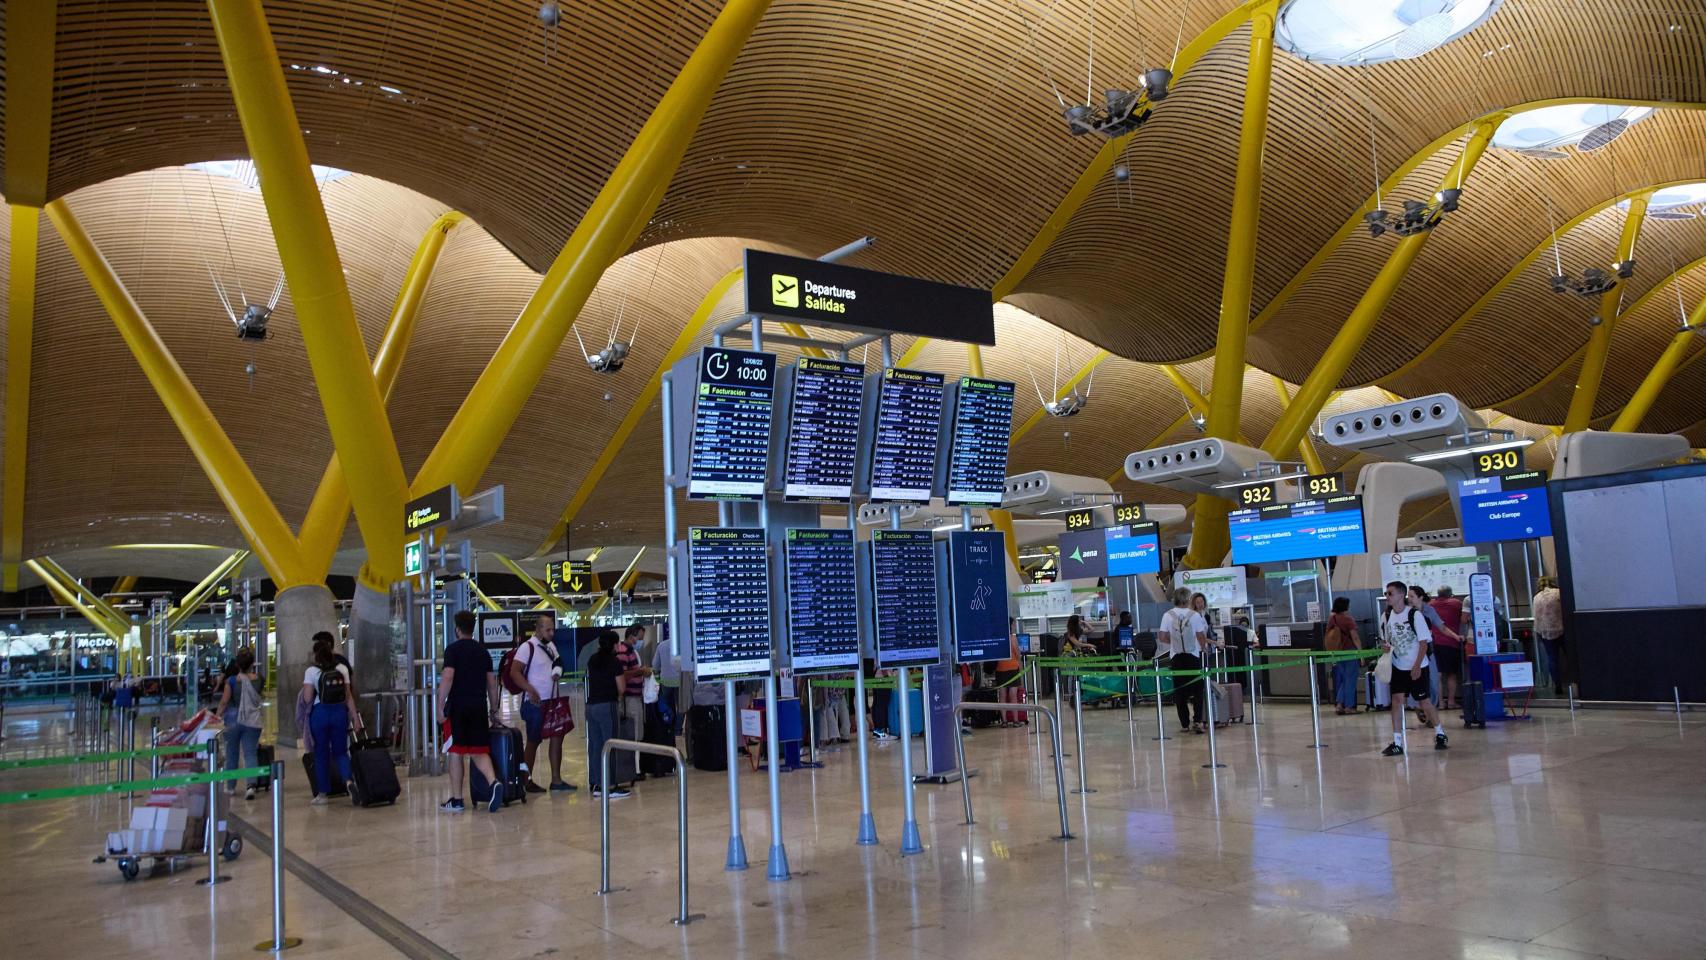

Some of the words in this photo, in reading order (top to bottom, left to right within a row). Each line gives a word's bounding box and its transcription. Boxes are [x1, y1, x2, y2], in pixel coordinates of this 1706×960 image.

[804, 280, 856, 300] Departures
[805, 295, 846, 314] Salidas
[809, 361, 840, 371] Facturación
[736, 366, 767, 381] 10:00
[894, 371, 923, 380] Facturación
[711, 387, 746, 397] Facturación
[1479, 451, 1518, 472] 930
[1309, 477, 1338, 495] 931
[1243, 486, 1271, 504] 932
[1068, 512, 1090, 528] 934
[1117, 506, 1141, 521] 933
[798, 531, 829, 539] Facturación
[1082, 550, 1098, 558] aena
[1109, 551, 1128, 560] BRITISH
[485, 624, 512, 636] DIVA
[77, 637, 116, 648] McDo
